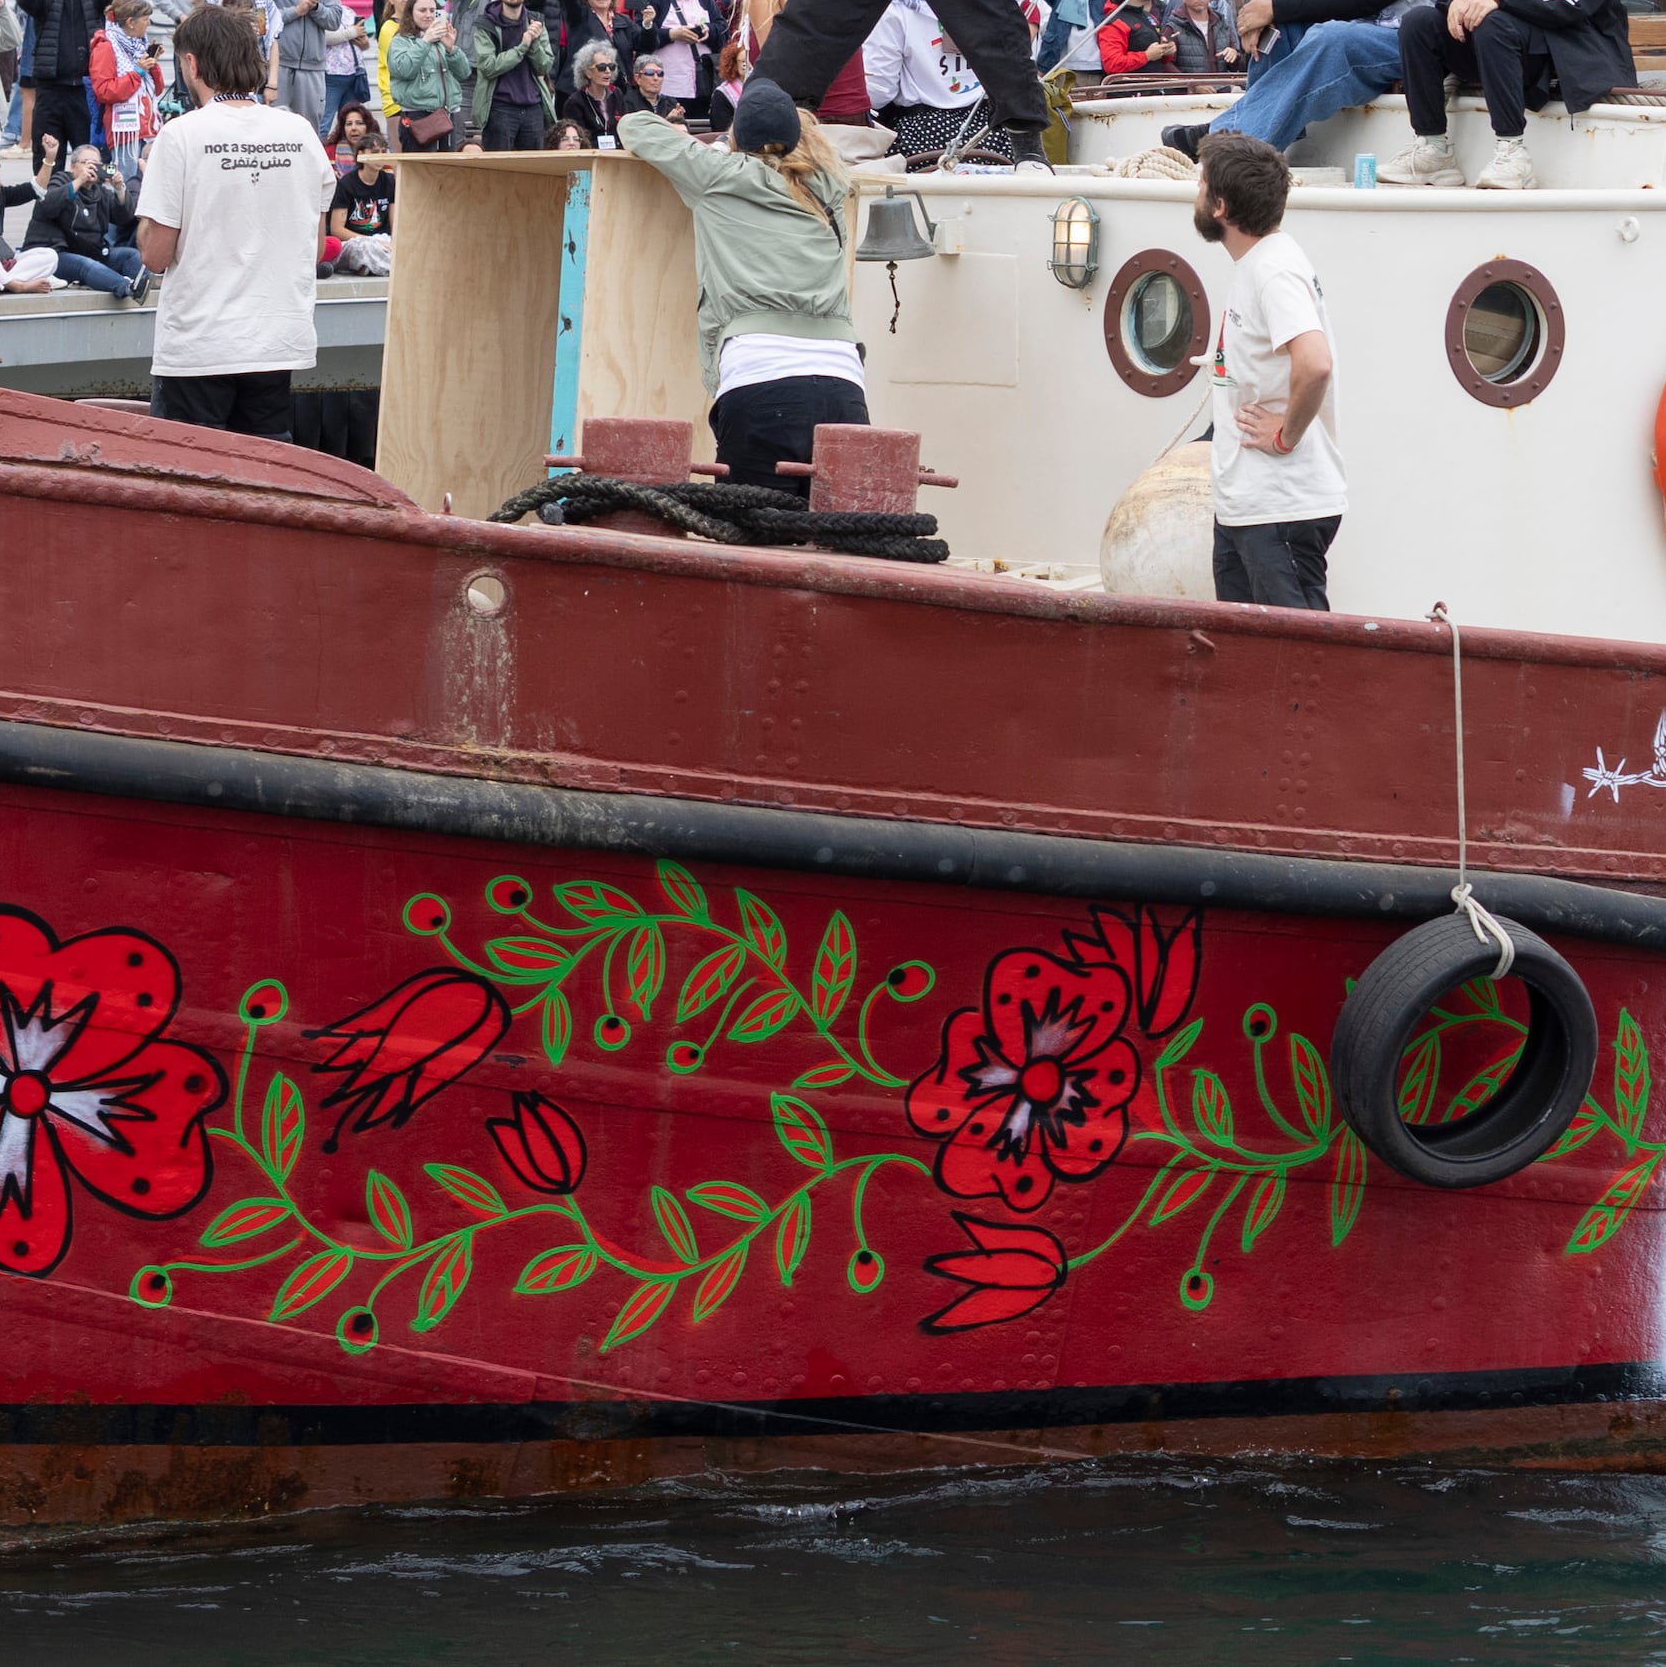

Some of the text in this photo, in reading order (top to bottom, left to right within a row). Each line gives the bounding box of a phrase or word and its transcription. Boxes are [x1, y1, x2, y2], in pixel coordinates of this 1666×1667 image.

[204, 142, 303, 154] not a spectator
